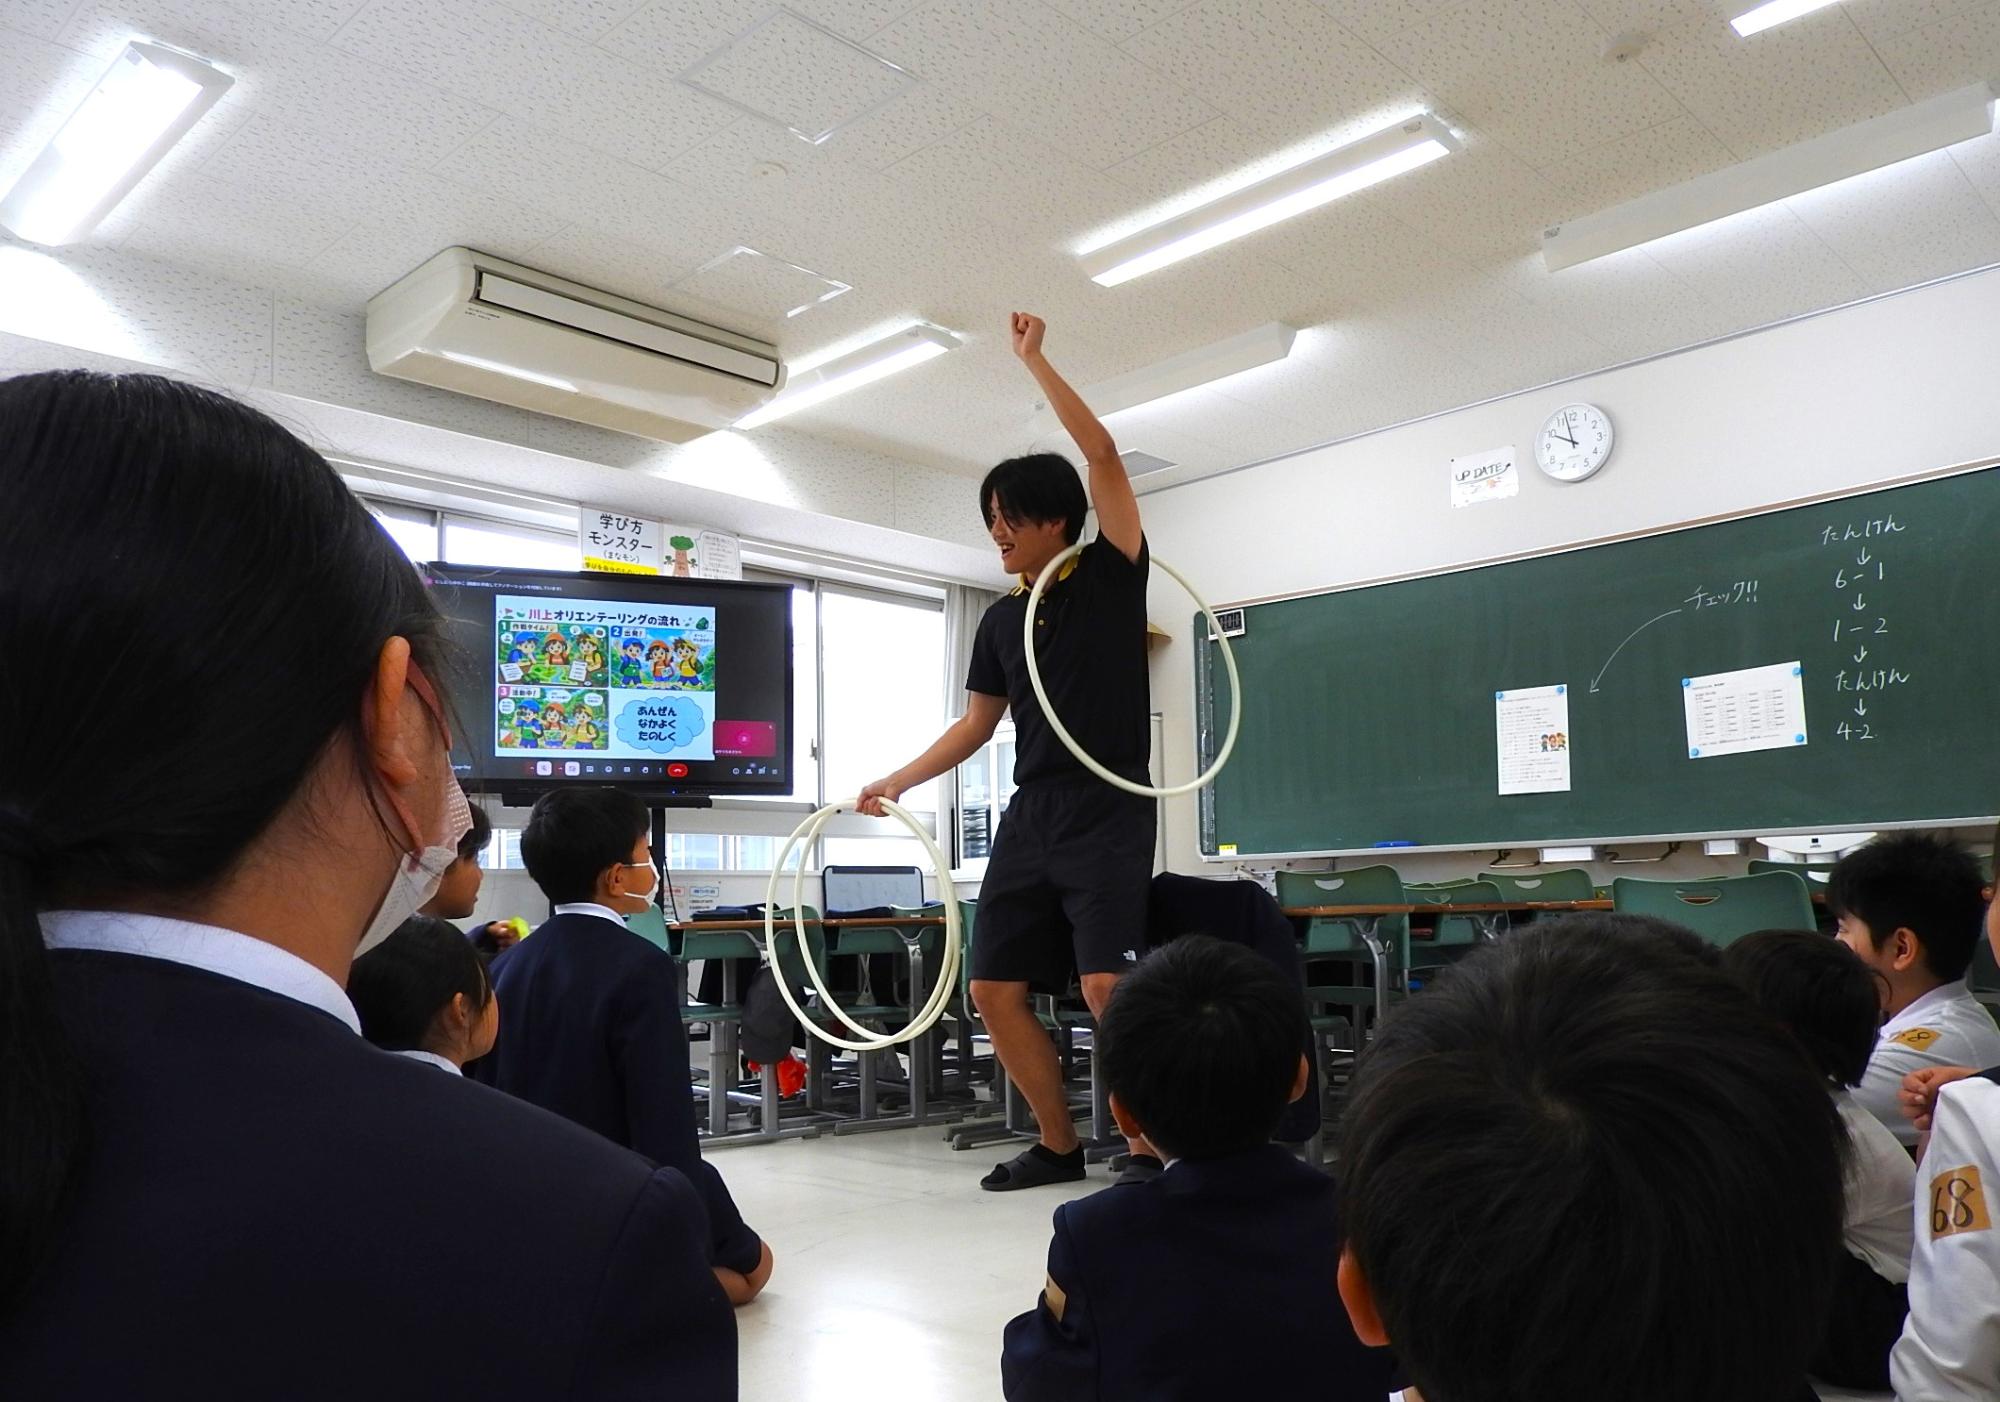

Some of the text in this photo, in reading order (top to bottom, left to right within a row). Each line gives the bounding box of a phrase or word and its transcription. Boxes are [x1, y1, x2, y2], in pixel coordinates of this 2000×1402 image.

[1455, 462, 1502, 482] UP DATE
[599, 512, 643, 535] 学び方
[1821, 514, 1906, 545] たんけん
[588, 531, 653, 551] モンスター
[528, 608, 680, 627] 川上オリエンテーリングの流れ
[1836, 667, 1910, 692] たんけん
[637, 705, 677, 717] あんぜん
[638, 719, 676, 729] なかよく
[638, 731, 676, 742] たのしく
[1932, 1177, 1974, 1233] 68
